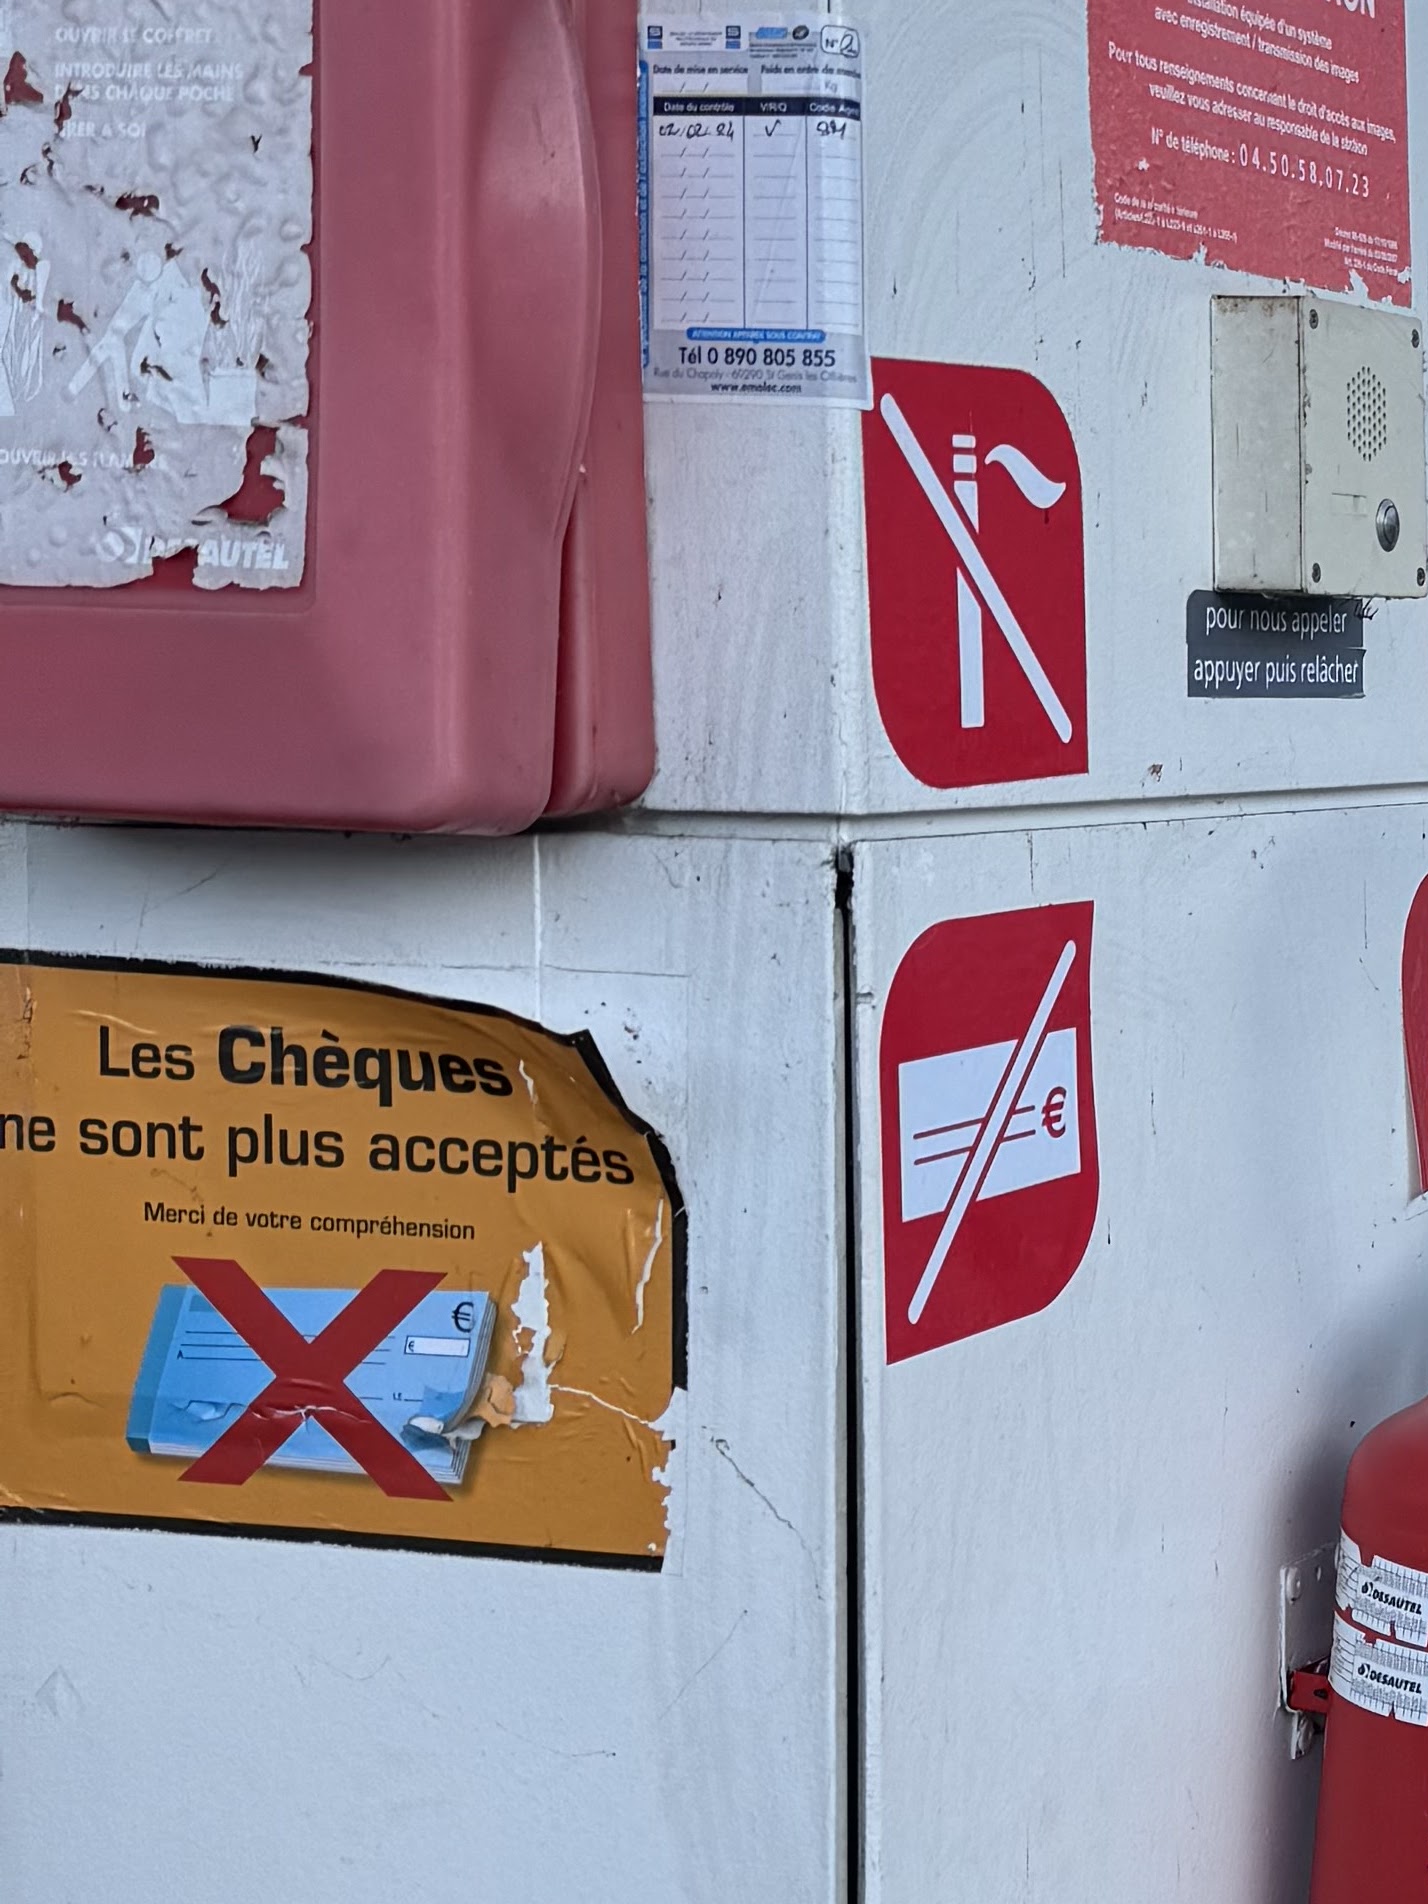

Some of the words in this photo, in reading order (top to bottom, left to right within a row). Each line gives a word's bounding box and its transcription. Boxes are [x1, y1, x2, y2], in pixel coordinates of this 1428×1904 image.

[1154, 6, 1178, 26] avec
[1180, 12, 1251, 50] enregistrement
[1257, 36, 1313, 70] transmission
[1313, 55, 1329, 75] des
[1330, 59, 1360, 84] images
[1240, 4, 1276, 32] équipée
[1277, 17, 1297, 39] d'un
[1297, 27, 1333, 51] système
[55, 62, 151, 80] INTRODUIRE
[157, 62, 183, 79] LES
[653, 64, 671, 75] Date
[673, 64, 686, 75] de
[686, 64, 706, 75] mise
[707, 66, 719, 75] en
[719, 65, 749, 76] service
[664, 102, 685, 113] Date
[686, 102, 698, 113] du
[699, 102, 735, 114] contrôle
[809, 102, 837, 114] Code
[1108, 41, 1134, 64] Pour
[1134, 50, 1158, 72] tous
[1158, 57, 1235, 93] renseignements
[1236, 82, 1287, 110] concernant
[1287, 92, 1297, 110] le
[1297, 97, 1318, 119] droit
[1317, 103, 1350, 128] d'accès
[1350, 116, 1366, 132] aux
[1366, 116, 1397, 144] images,
[1149, 83, 1186, 105] veuillez
[1186, 94, 1210, 113] vous
[1211, 97, 1252, 124] adresser
[1253, 111, 1266, 127] au
[1266, 115, 1319, 142] responsable
[1319, 128, 1332, 145] de
[1331, 130, 1340, 149] la
[1151, 127, 1164, 145] N°
[1166, 130, 1180, 151] de
[1180, 135, 1230, 164] téléphone
[654, 367, 671, 378] Rue
[672, 367, 684, 378] du
[679, 346, 702, 365] Tél
[707, 348, 719, 365] 0
[724, 348, 758, 366] 890
[763, 349, 796, 367] 805
[802, 349, 836, 367] 855
[1206, 603, 1245, 637] pour
[1249, 604, 1287, 632] nous
[1291, 607, 1348, 640] appeler
[1193, 655, 1261, 692] appuyer
[1265, 655, 1297, 686] puis
[1300, 655, 1359, 685] relâcher
[99, 1025, 196, 1080] Les
[217, 1024, 514, 1107] Chèques
[0, 1113, 56, 1153] ne
[79, 1115, 206, 1162] sont
[227, 1113, 345, 1177] plus
[368, 1132, 636, 1193] acceptés
[143, 1201, 206, 1225] Merci
[213, 1206, 238, 1227] de
[245, 1210, 302, 1231] votre
[309, 1212, 476, 1241] compréhension
[1372, 1589, 1423, 1616] DESAUTEL
[1369, 1670, 1423, 1695] DESAUTEL
